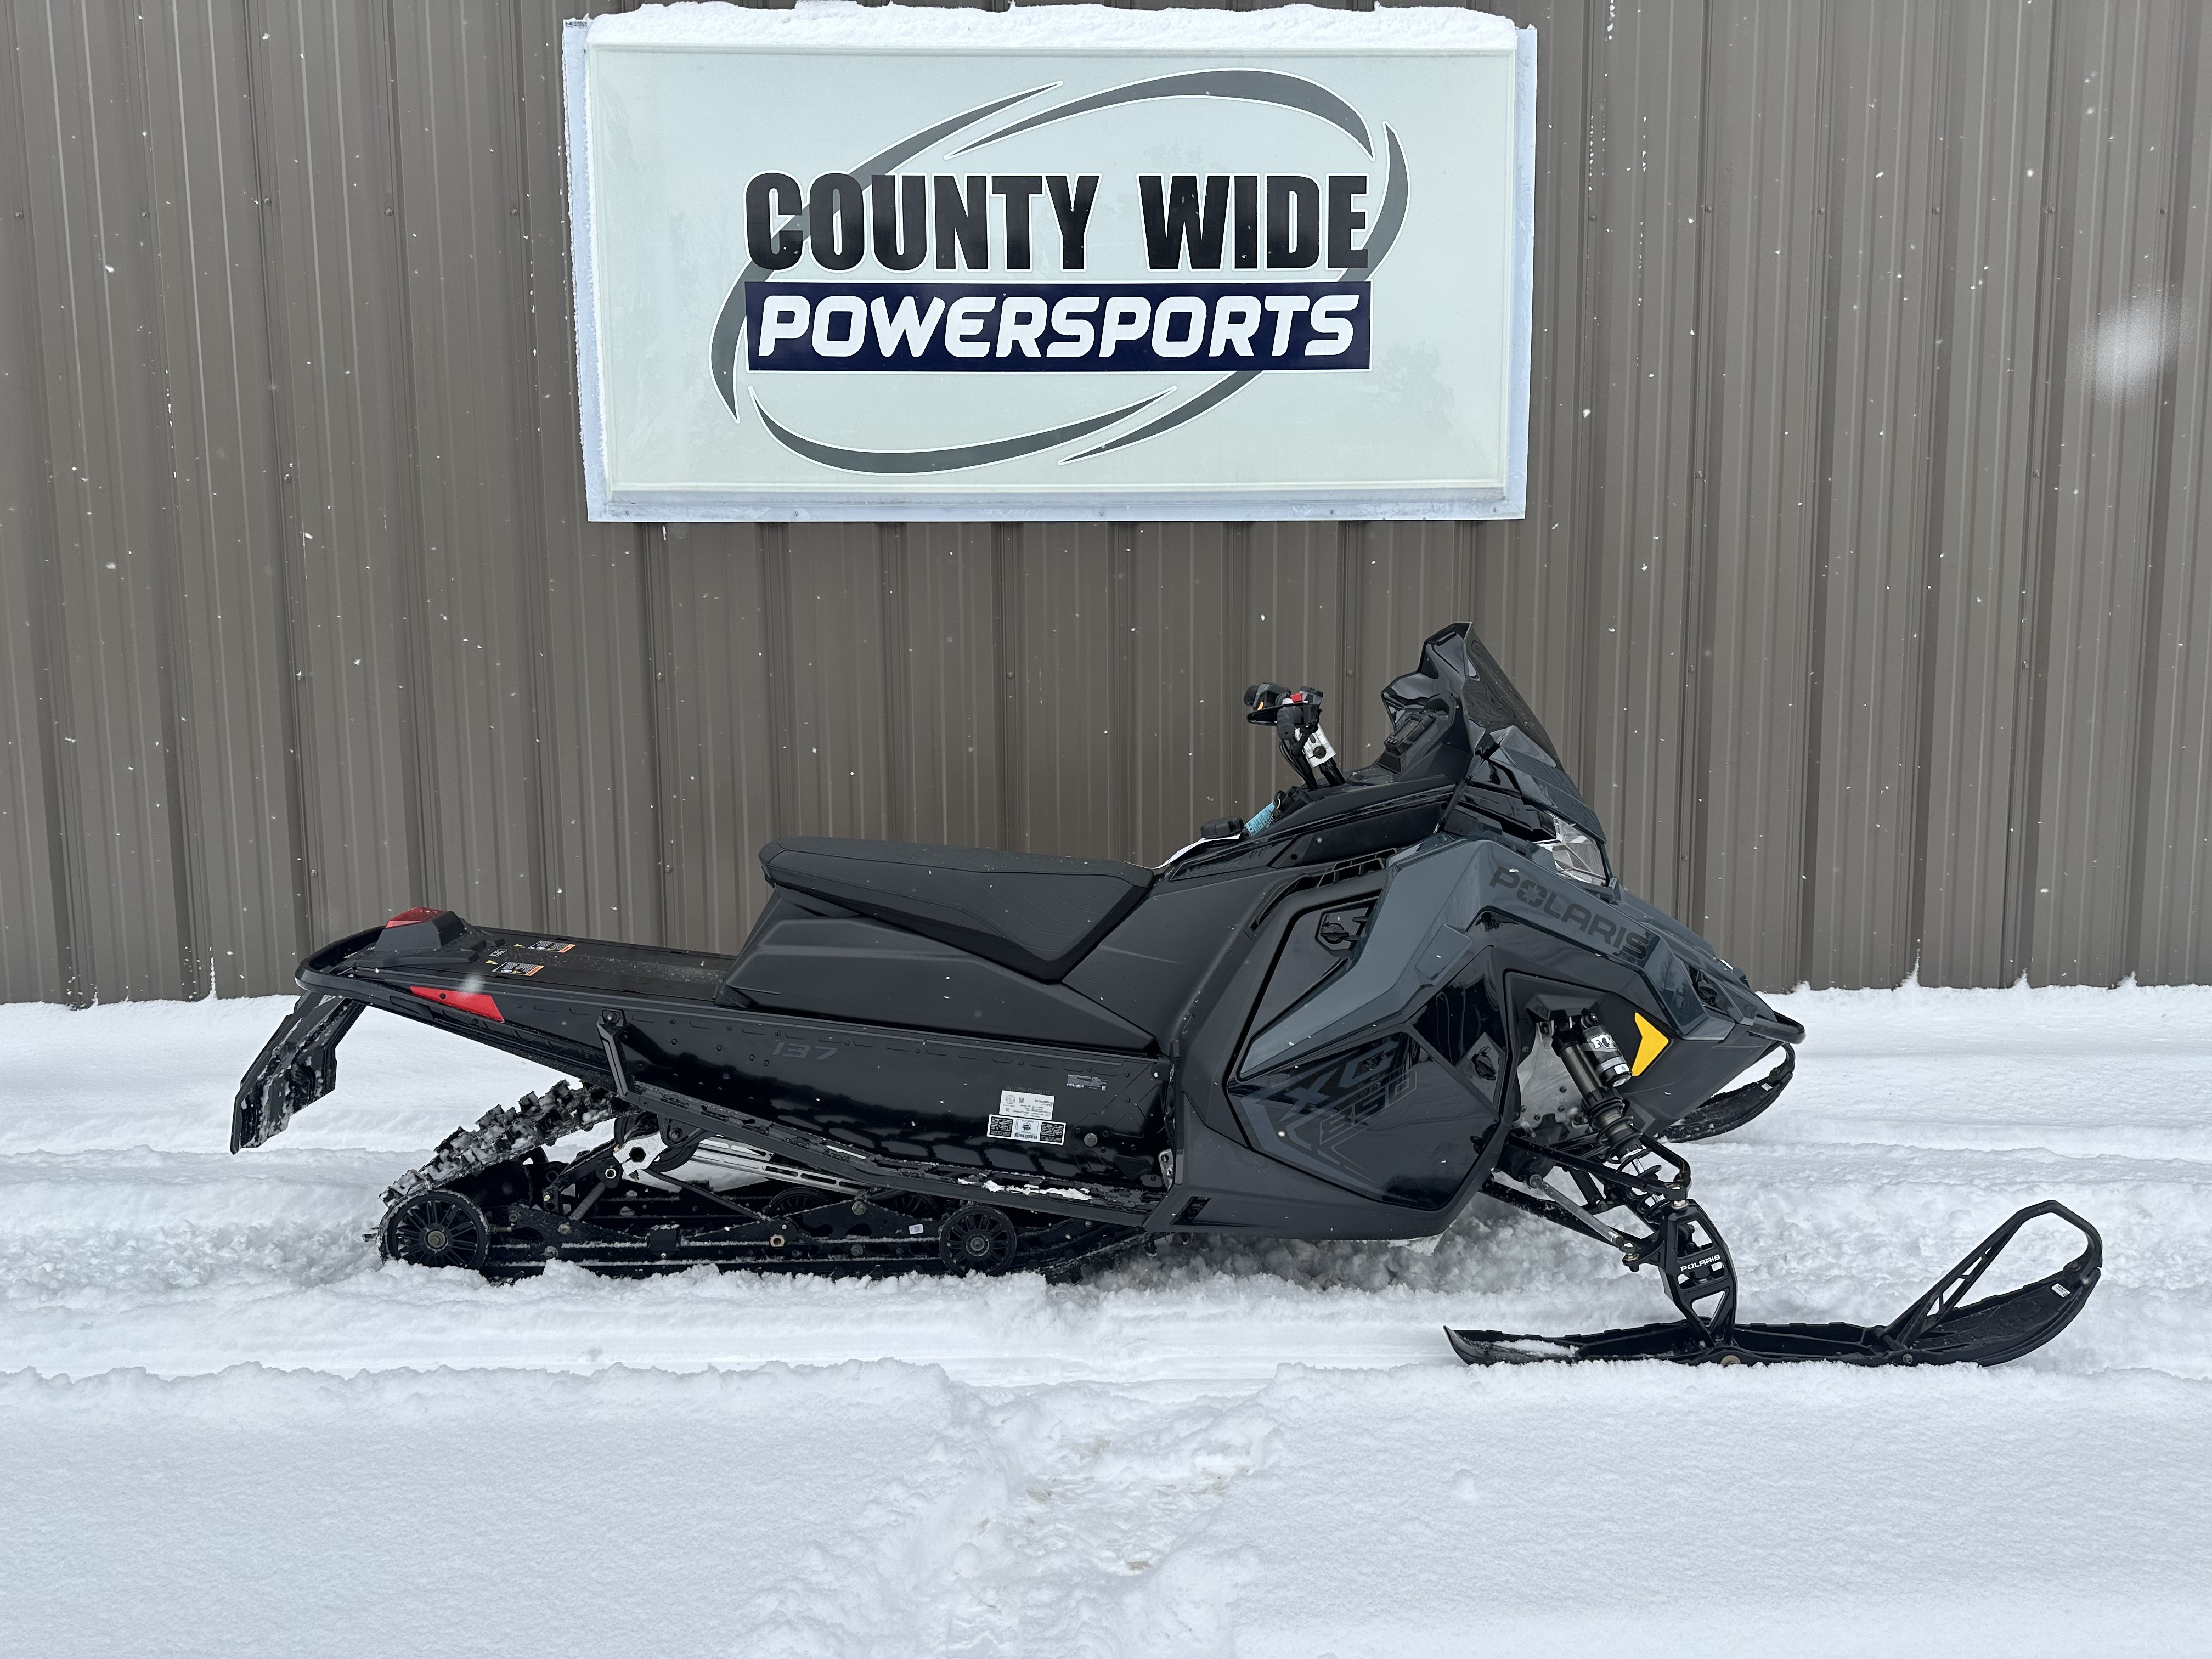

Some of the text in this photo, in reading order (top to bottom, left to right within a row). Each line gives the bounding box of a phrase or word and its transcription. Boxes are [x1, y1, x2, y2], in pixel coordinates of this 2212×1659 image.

[746, 173, 1368, 270] COUNTY WIDE
[758, 294, 1359, 358] POWERSPORTS
[1184, 861, 1243, 877] MATRYX
[1489, 866, 1650, 960] POLARIS
[772, 1042, 838, 1060] 137
[1680, 1254, 1720, 1272] POLARIS
